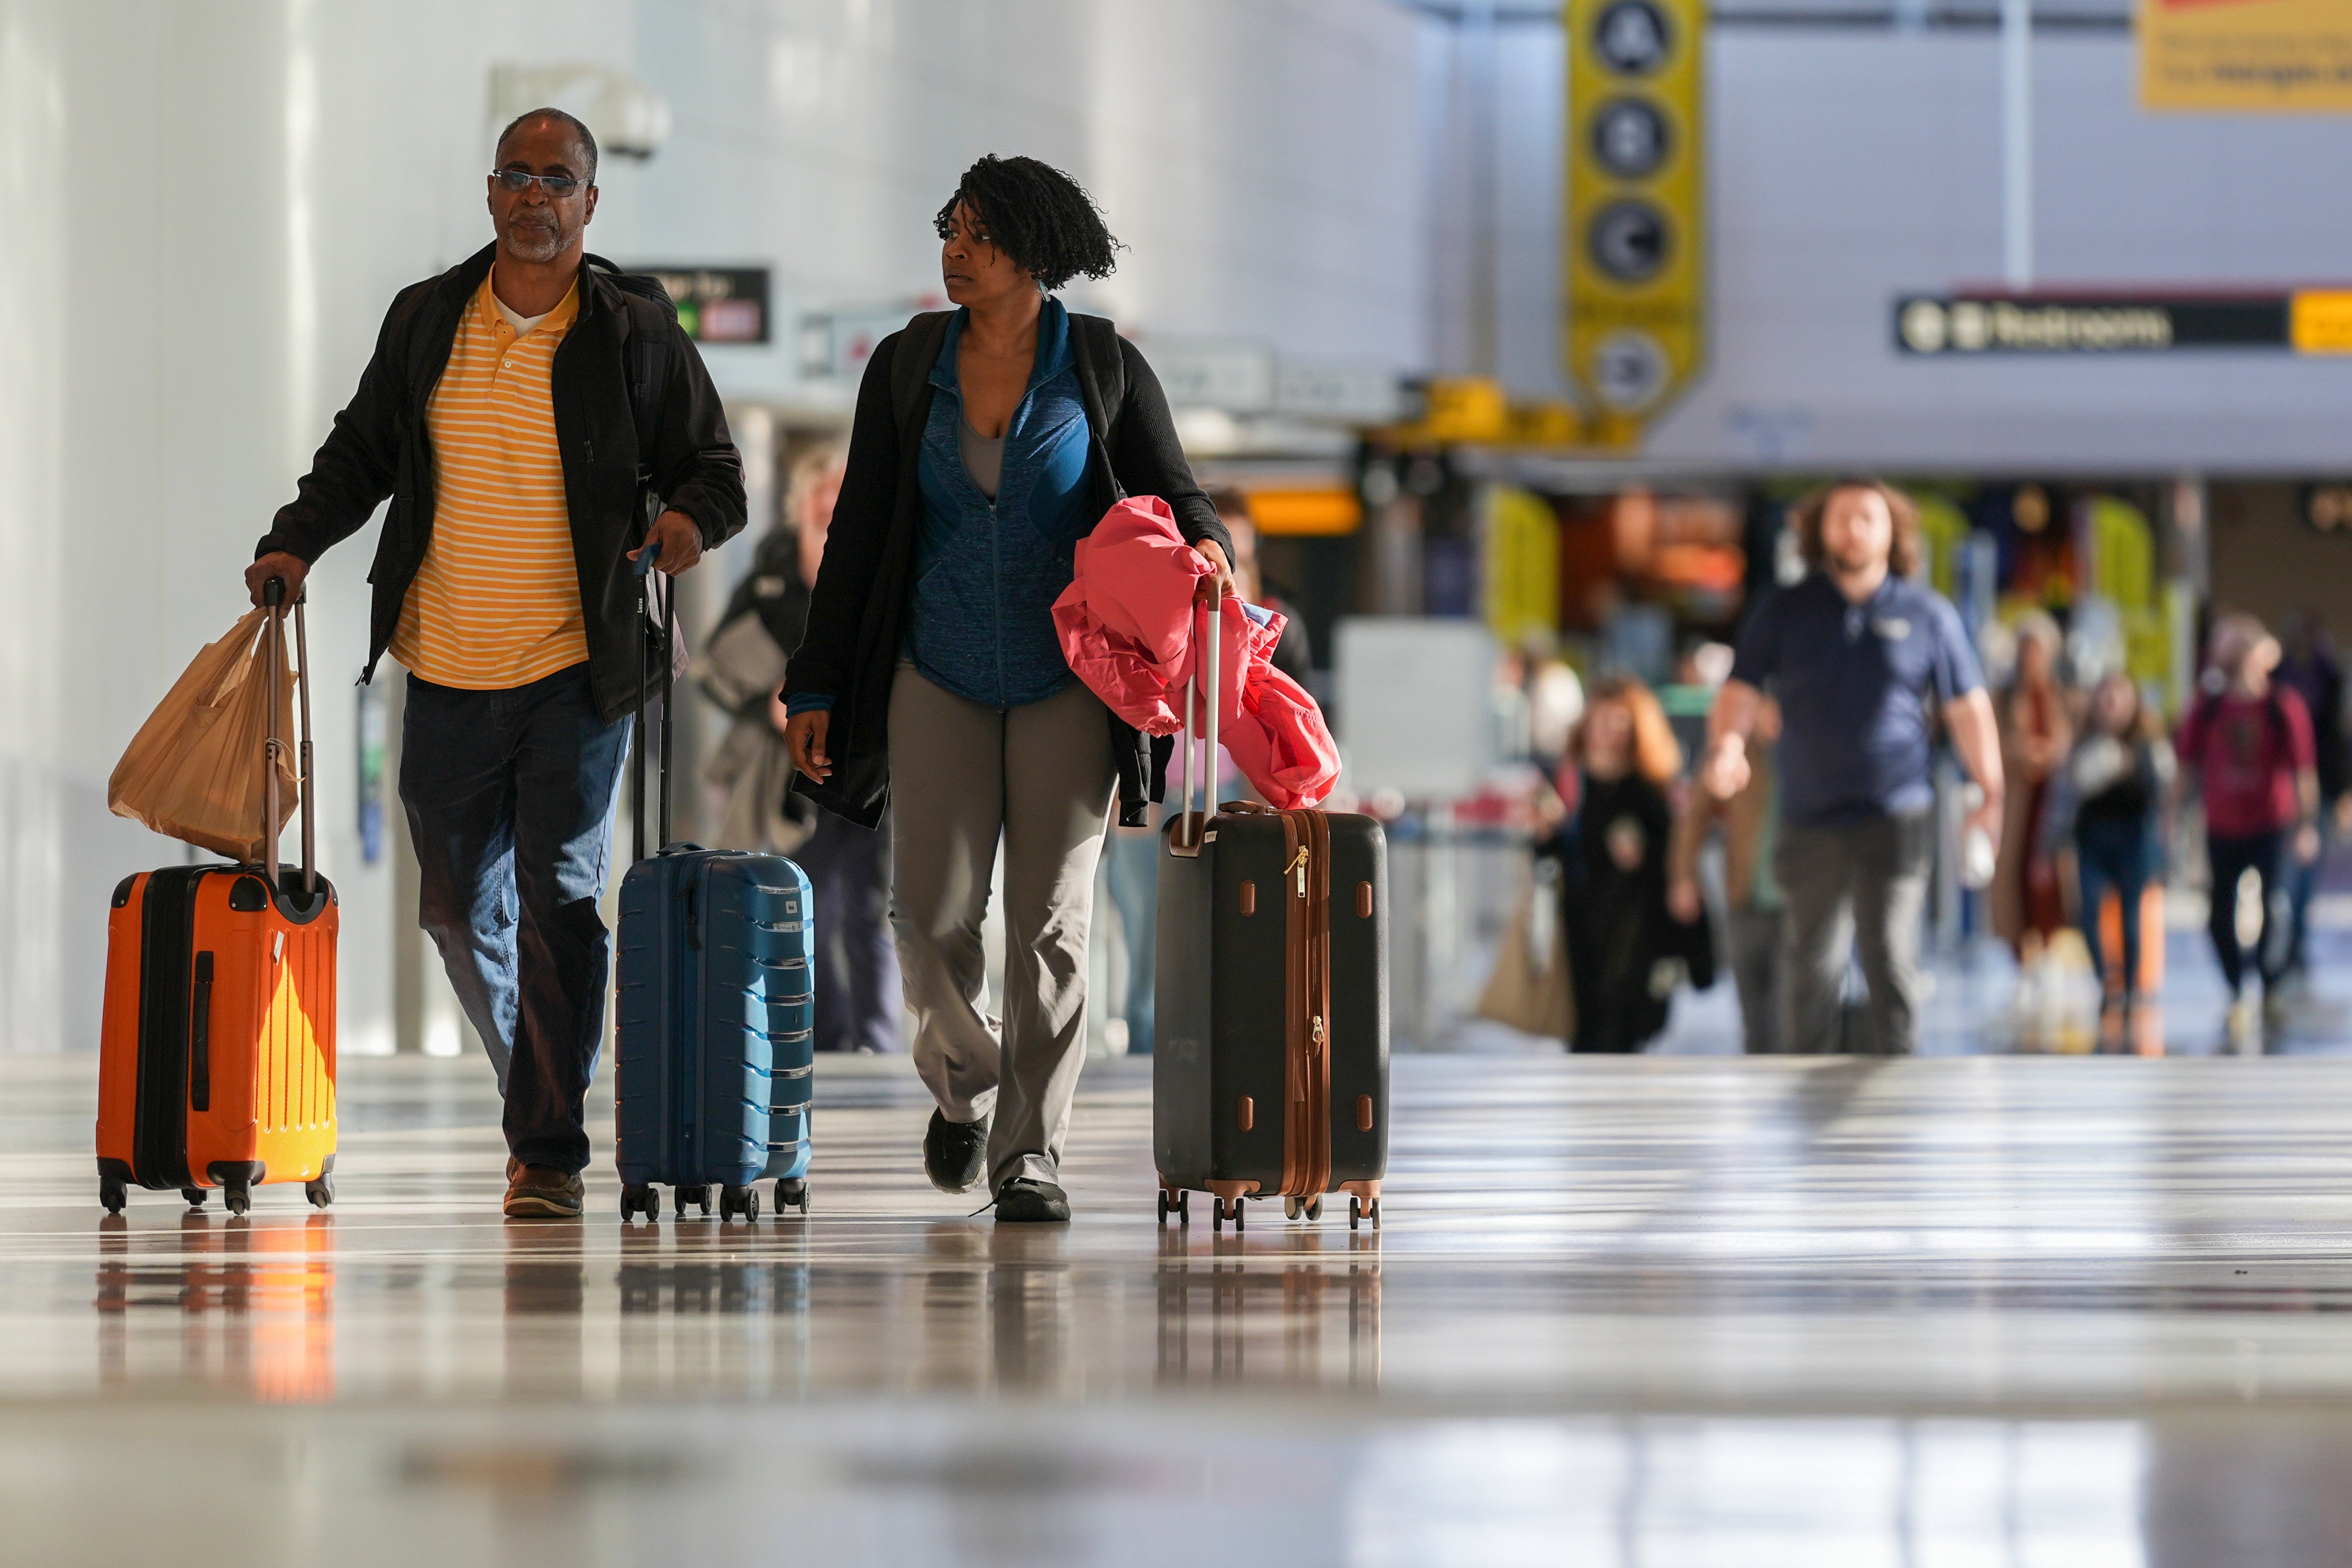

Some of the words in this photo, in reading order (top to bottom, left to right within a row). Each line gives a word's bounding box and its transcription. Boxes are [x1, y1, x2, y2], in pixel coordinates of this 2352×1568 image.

[1602, 4, 1664, 67] A
[1604, 106, 1655, 169] B
[1599, 211, 1660, 275] C
